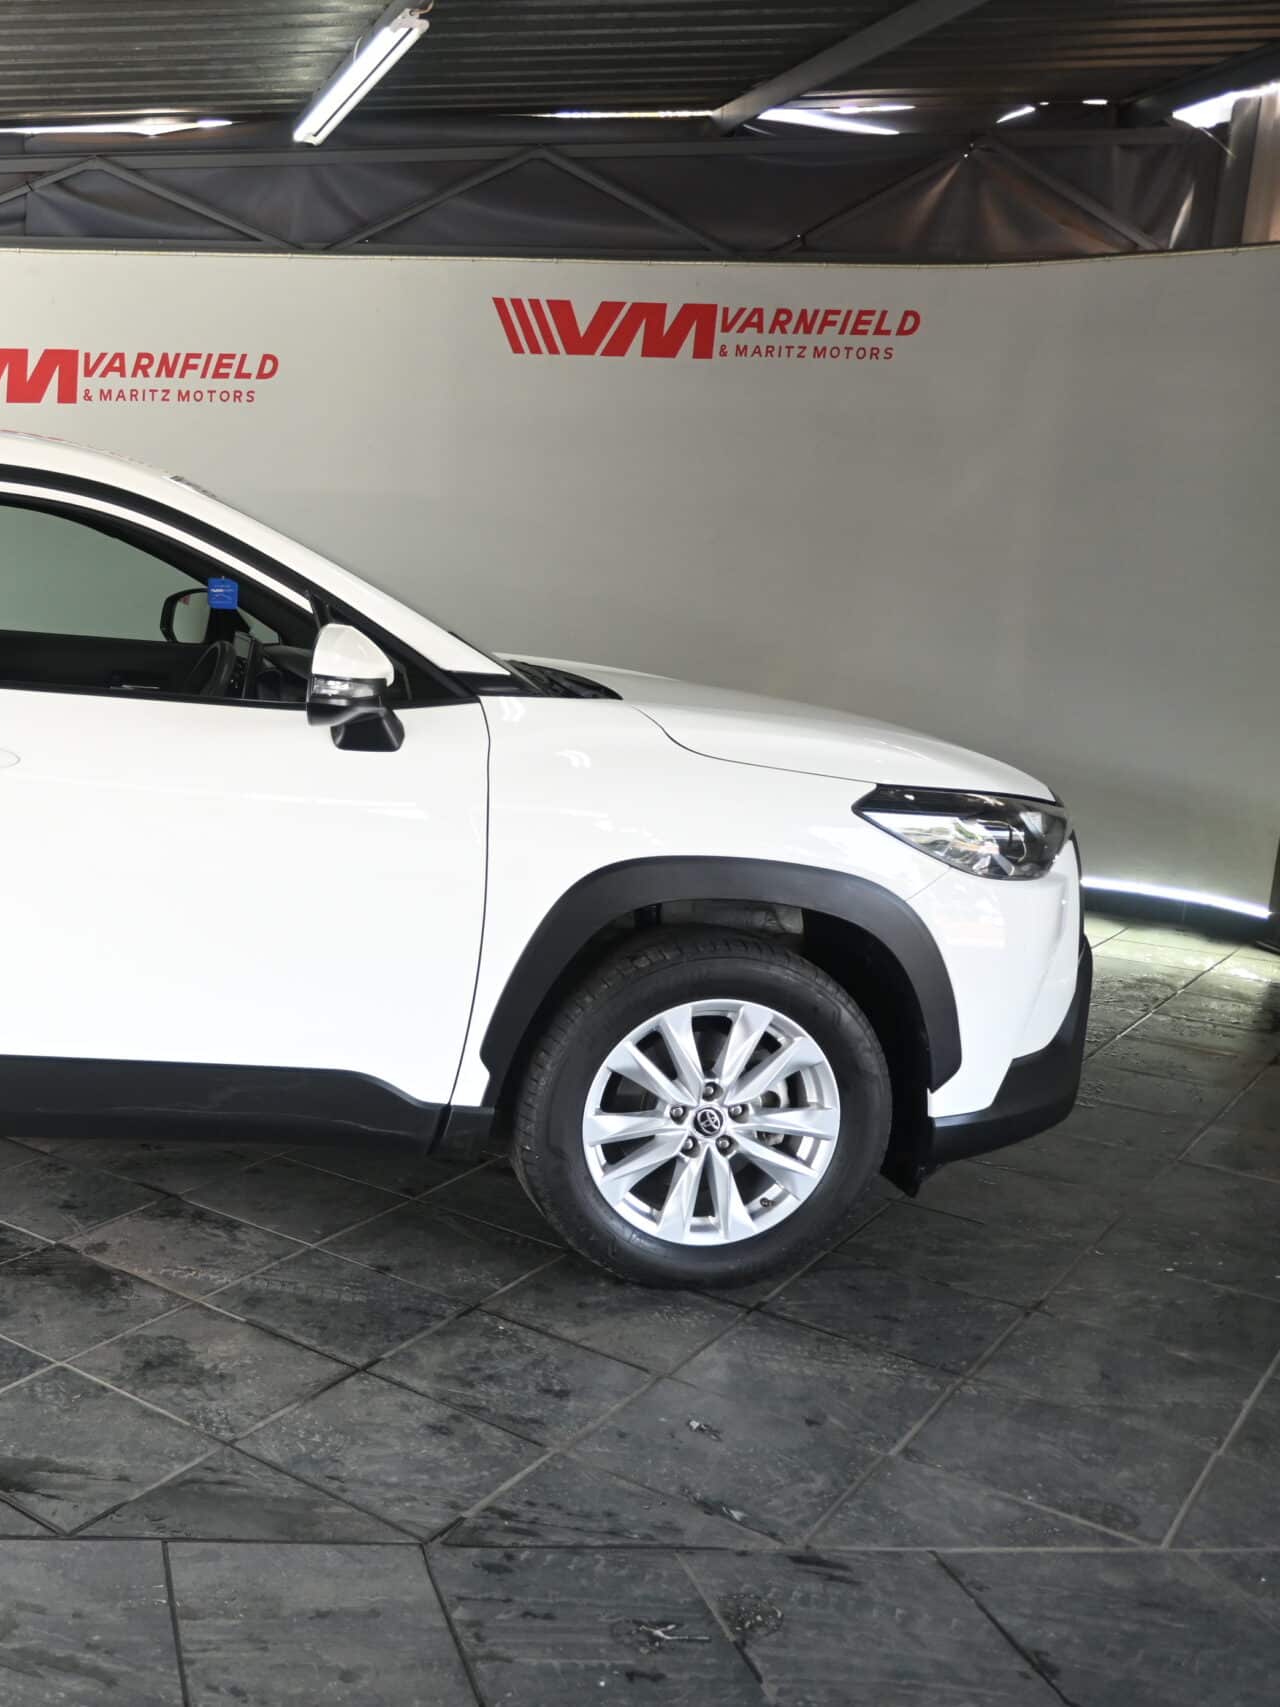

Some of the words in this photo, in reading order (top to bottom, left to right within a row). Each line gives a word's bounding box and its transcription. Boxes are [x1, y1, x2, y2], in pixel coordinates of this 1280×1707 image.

[547, 299, 718, 360] VM
[721, 306, 922, 337] VARNFIELD
[82, 351, 279, 380] VARNFIELD
[719, 344, 728, 357] &
[735, 344, 807, 359] MARITZ
[812, 346, 894, 361] MOTORS
[83, 389, 93, 402] &
[99, 388, 171, 402] MARITZ
[177, 389, 256, 403] MOTORS
